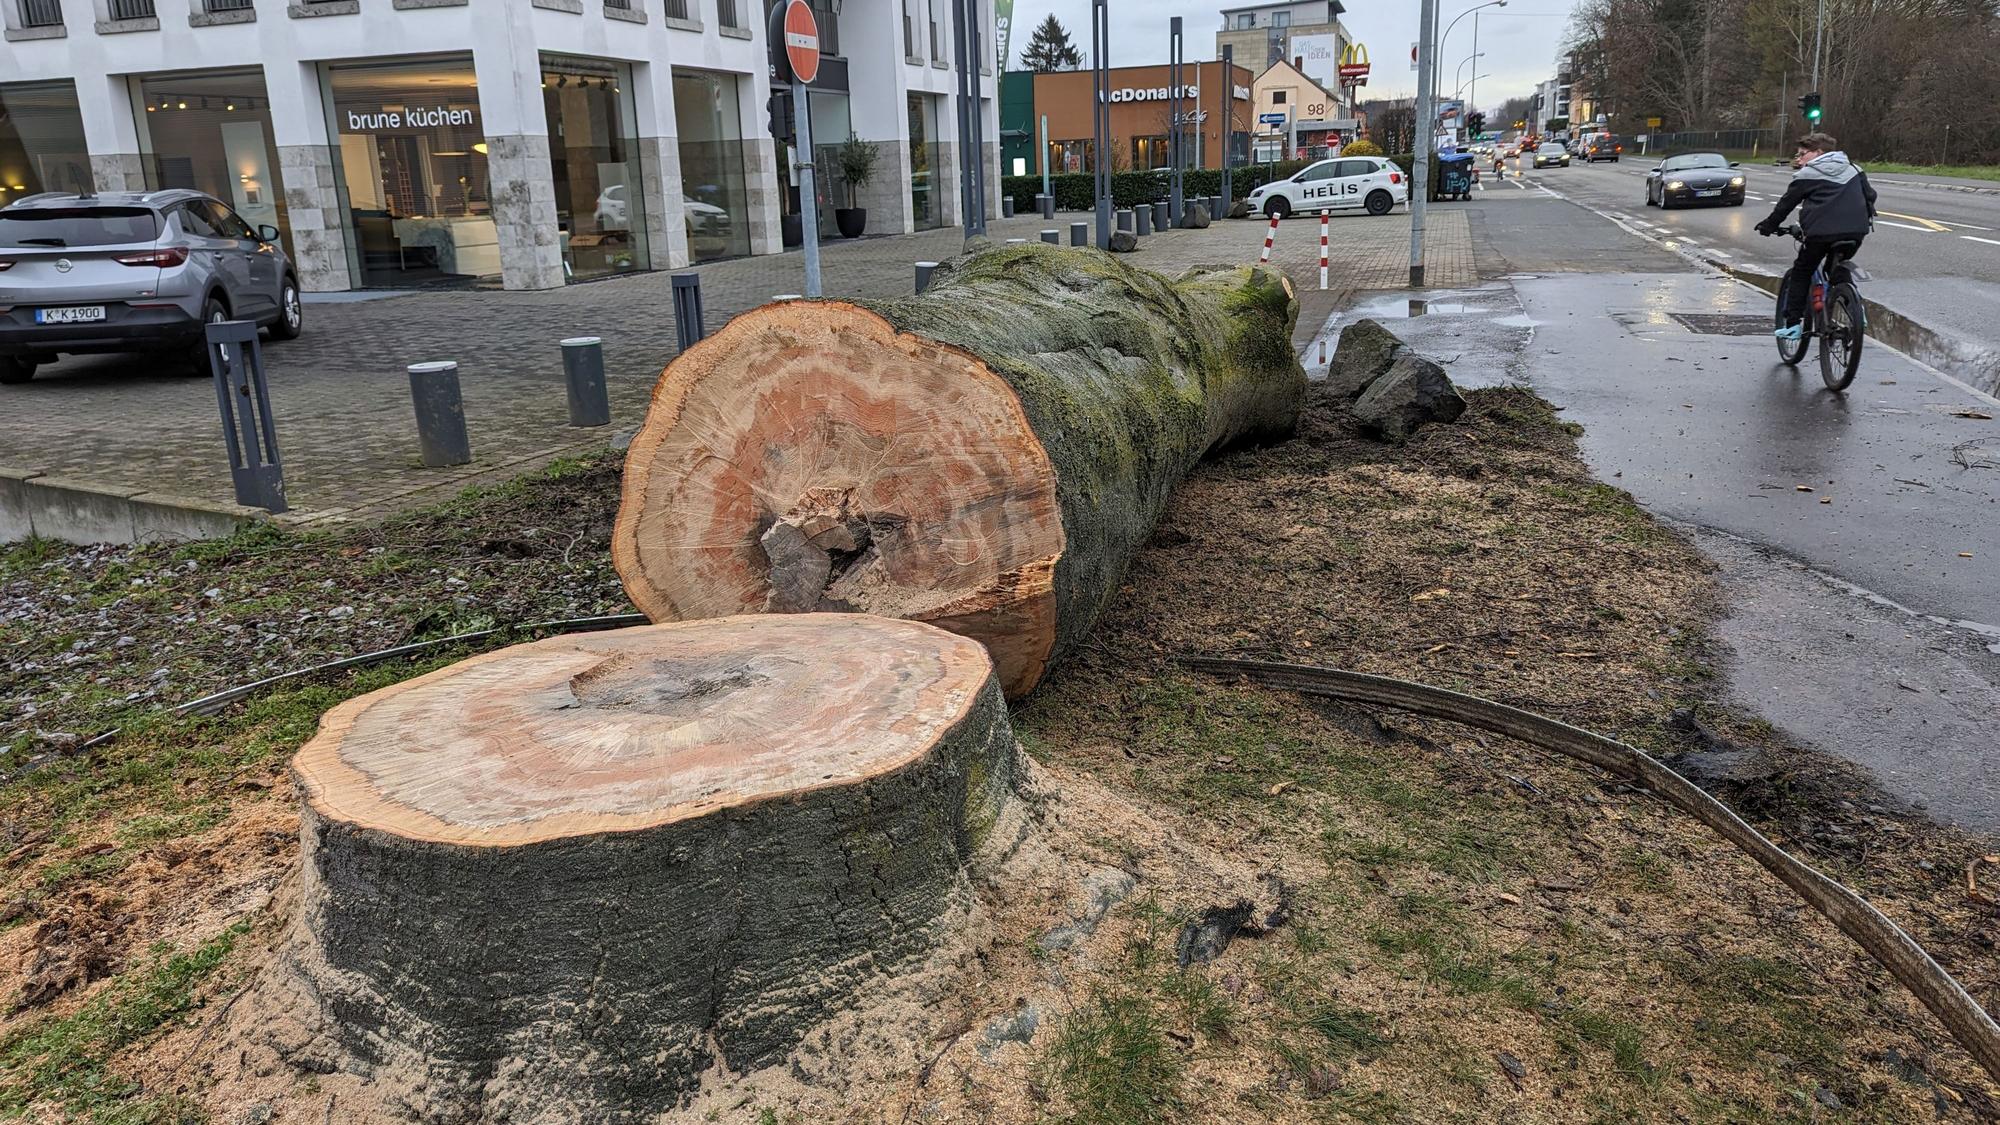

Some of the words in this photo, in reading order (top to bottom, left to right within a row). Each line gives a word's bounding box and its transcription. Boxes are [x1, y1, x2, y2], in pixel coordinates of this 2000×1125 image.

[1308, 51, 1331, 60] IDEEN
[1307, 104, 1325, 116] 98
[348, 110, 400, 130] brune
[405, 106, 473, 128] küchen
[46, 310, 54, 320] K
[60, 309, 69, 319] K
[71, 308, 100, 319] 1900
